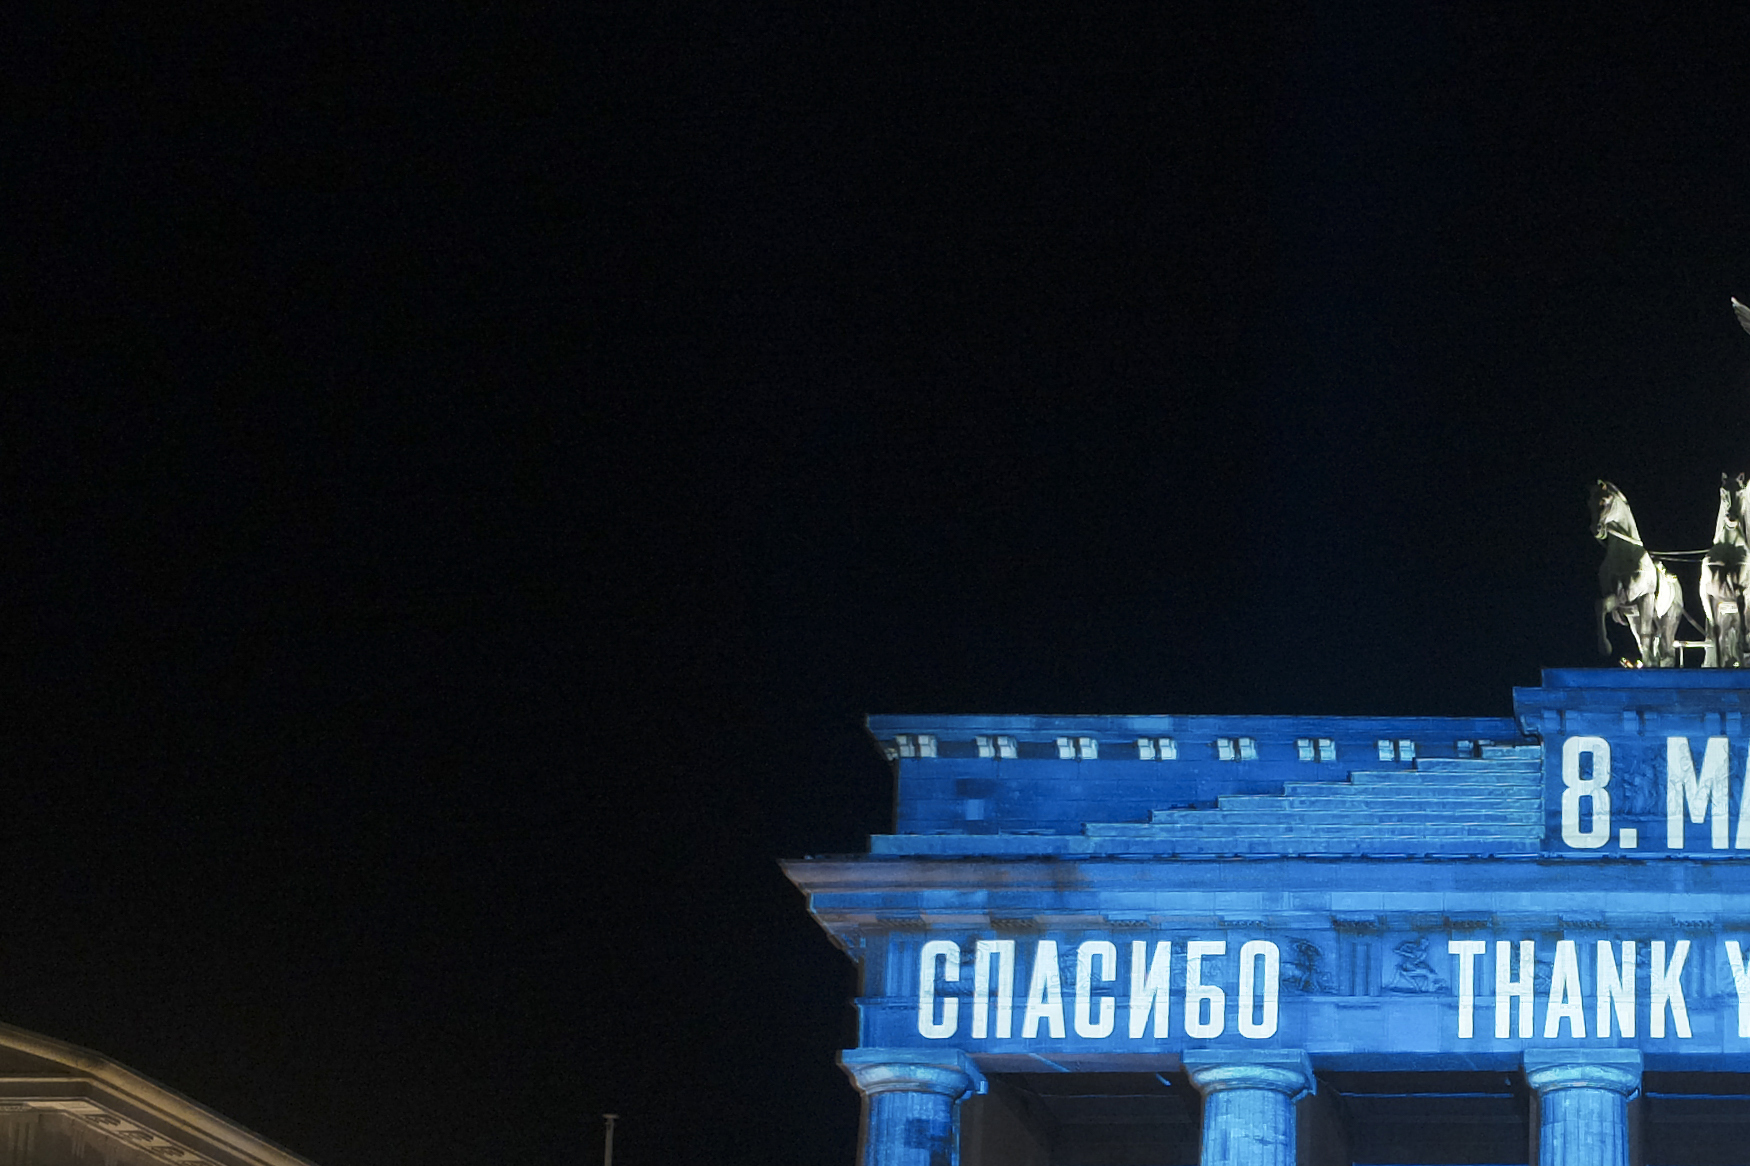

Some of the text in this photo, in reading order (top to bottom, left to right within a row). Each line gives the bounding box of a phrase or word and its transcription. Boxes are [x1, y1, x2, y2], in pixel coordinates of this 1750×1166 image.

[1561, 735, 1637, 849] 8.
[917, 940, 1280, 1040] СПАСИБО
[1448, 940, 1692, 1039] THANK
